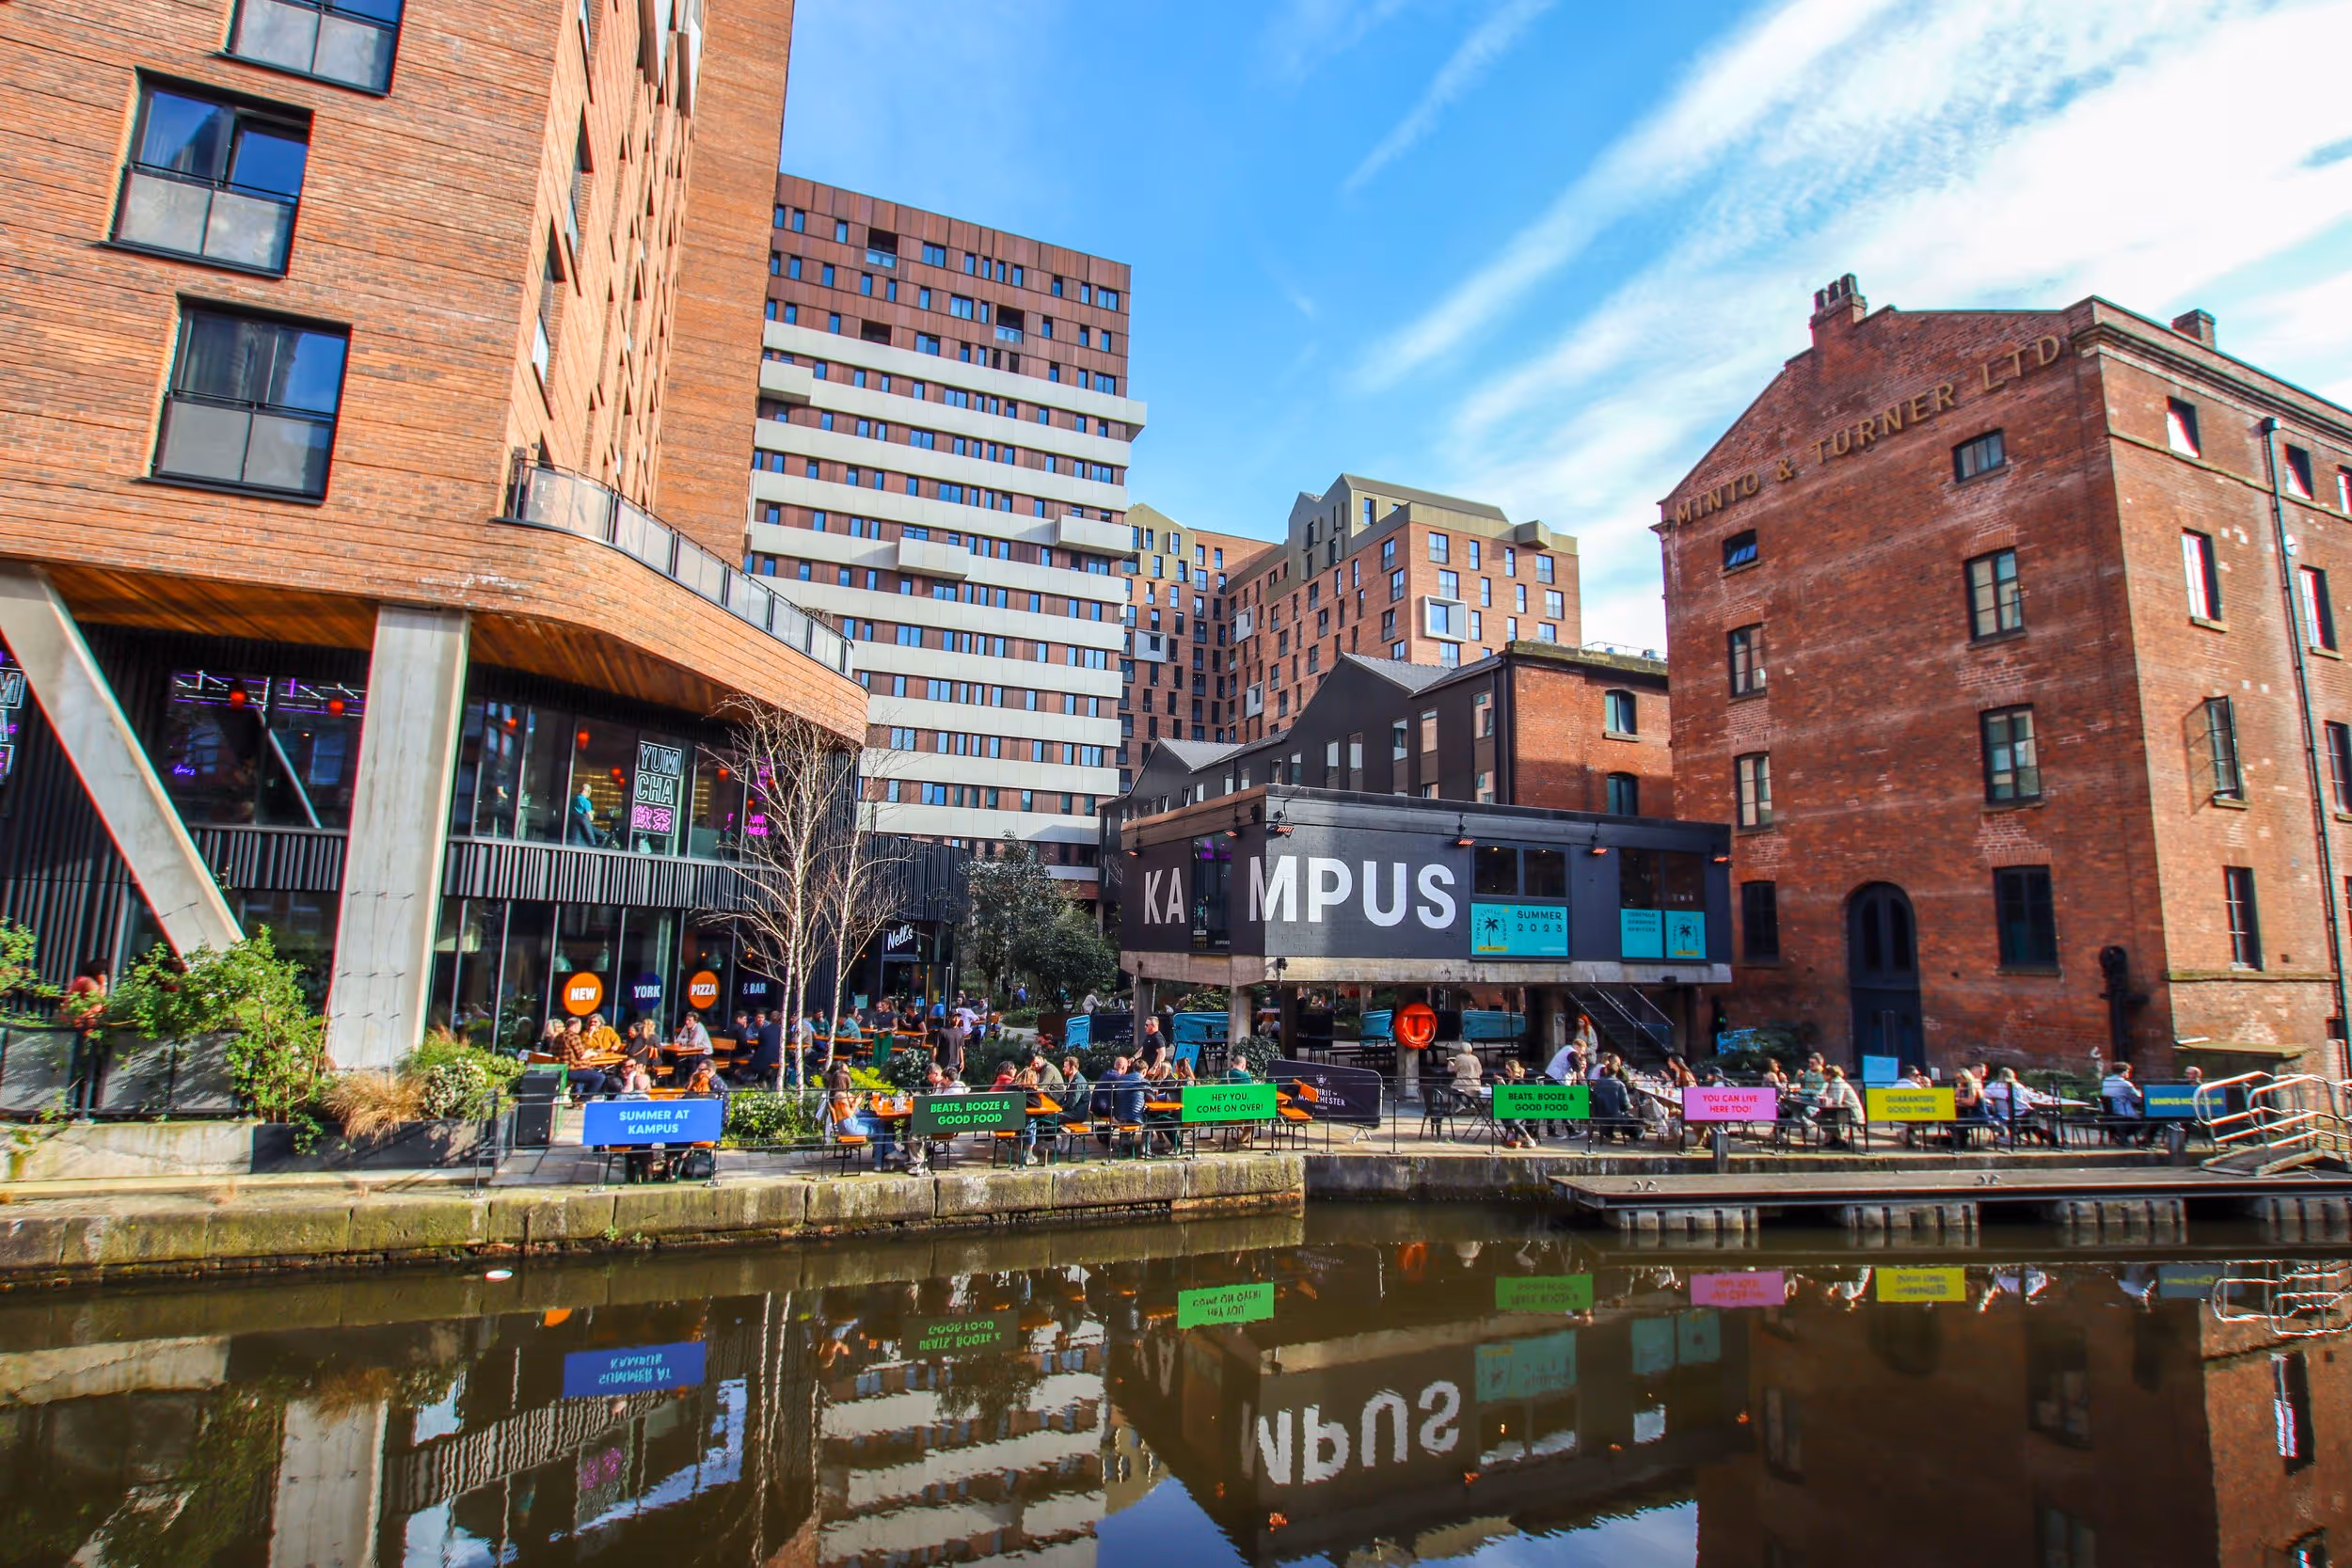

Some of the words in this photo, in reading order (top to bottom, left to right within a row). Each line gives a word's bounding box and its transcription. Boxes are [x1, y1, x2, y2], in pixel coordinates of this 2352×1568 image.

[1676, 472, 1759, 526] MINTO
[1776, 458, 1792, 481] &
[1808, 383, 1955, 465] TURNER
[1979, 335, 2060, 391] LTD
[641, 744, 678, 775] YUM
[636, 774, 674, 804] CHA
[633, 804, 672, 832] 飲茶
[1517, 910, 1562, 920] SUMMER
[887, 924, 914, 951] Nell's
[570, 987, 596, 1001] NEW
[634, 985, 660, 998] YORK
[691, 984, 716, 996] PIZZA
[743, 984, 748, 994] &
[750, 983, 766, 994] BAR
[930, 1102, 963, 1113] BEATS,
[966, 1101, 1000, 1112] BOOZE
[1003, 1101, 1009, 1110] &
[1197, 1104, 1221, 1113] COME
[619, 1110, 671, 1121] SUMMER
[675, 1109, 690, 1119] AT
[937, 1115, 970, 1125] GOOD
[973, 1113, 1002, 1124] FOOD
[628, 1123, 678, 1134] KAMPUS
